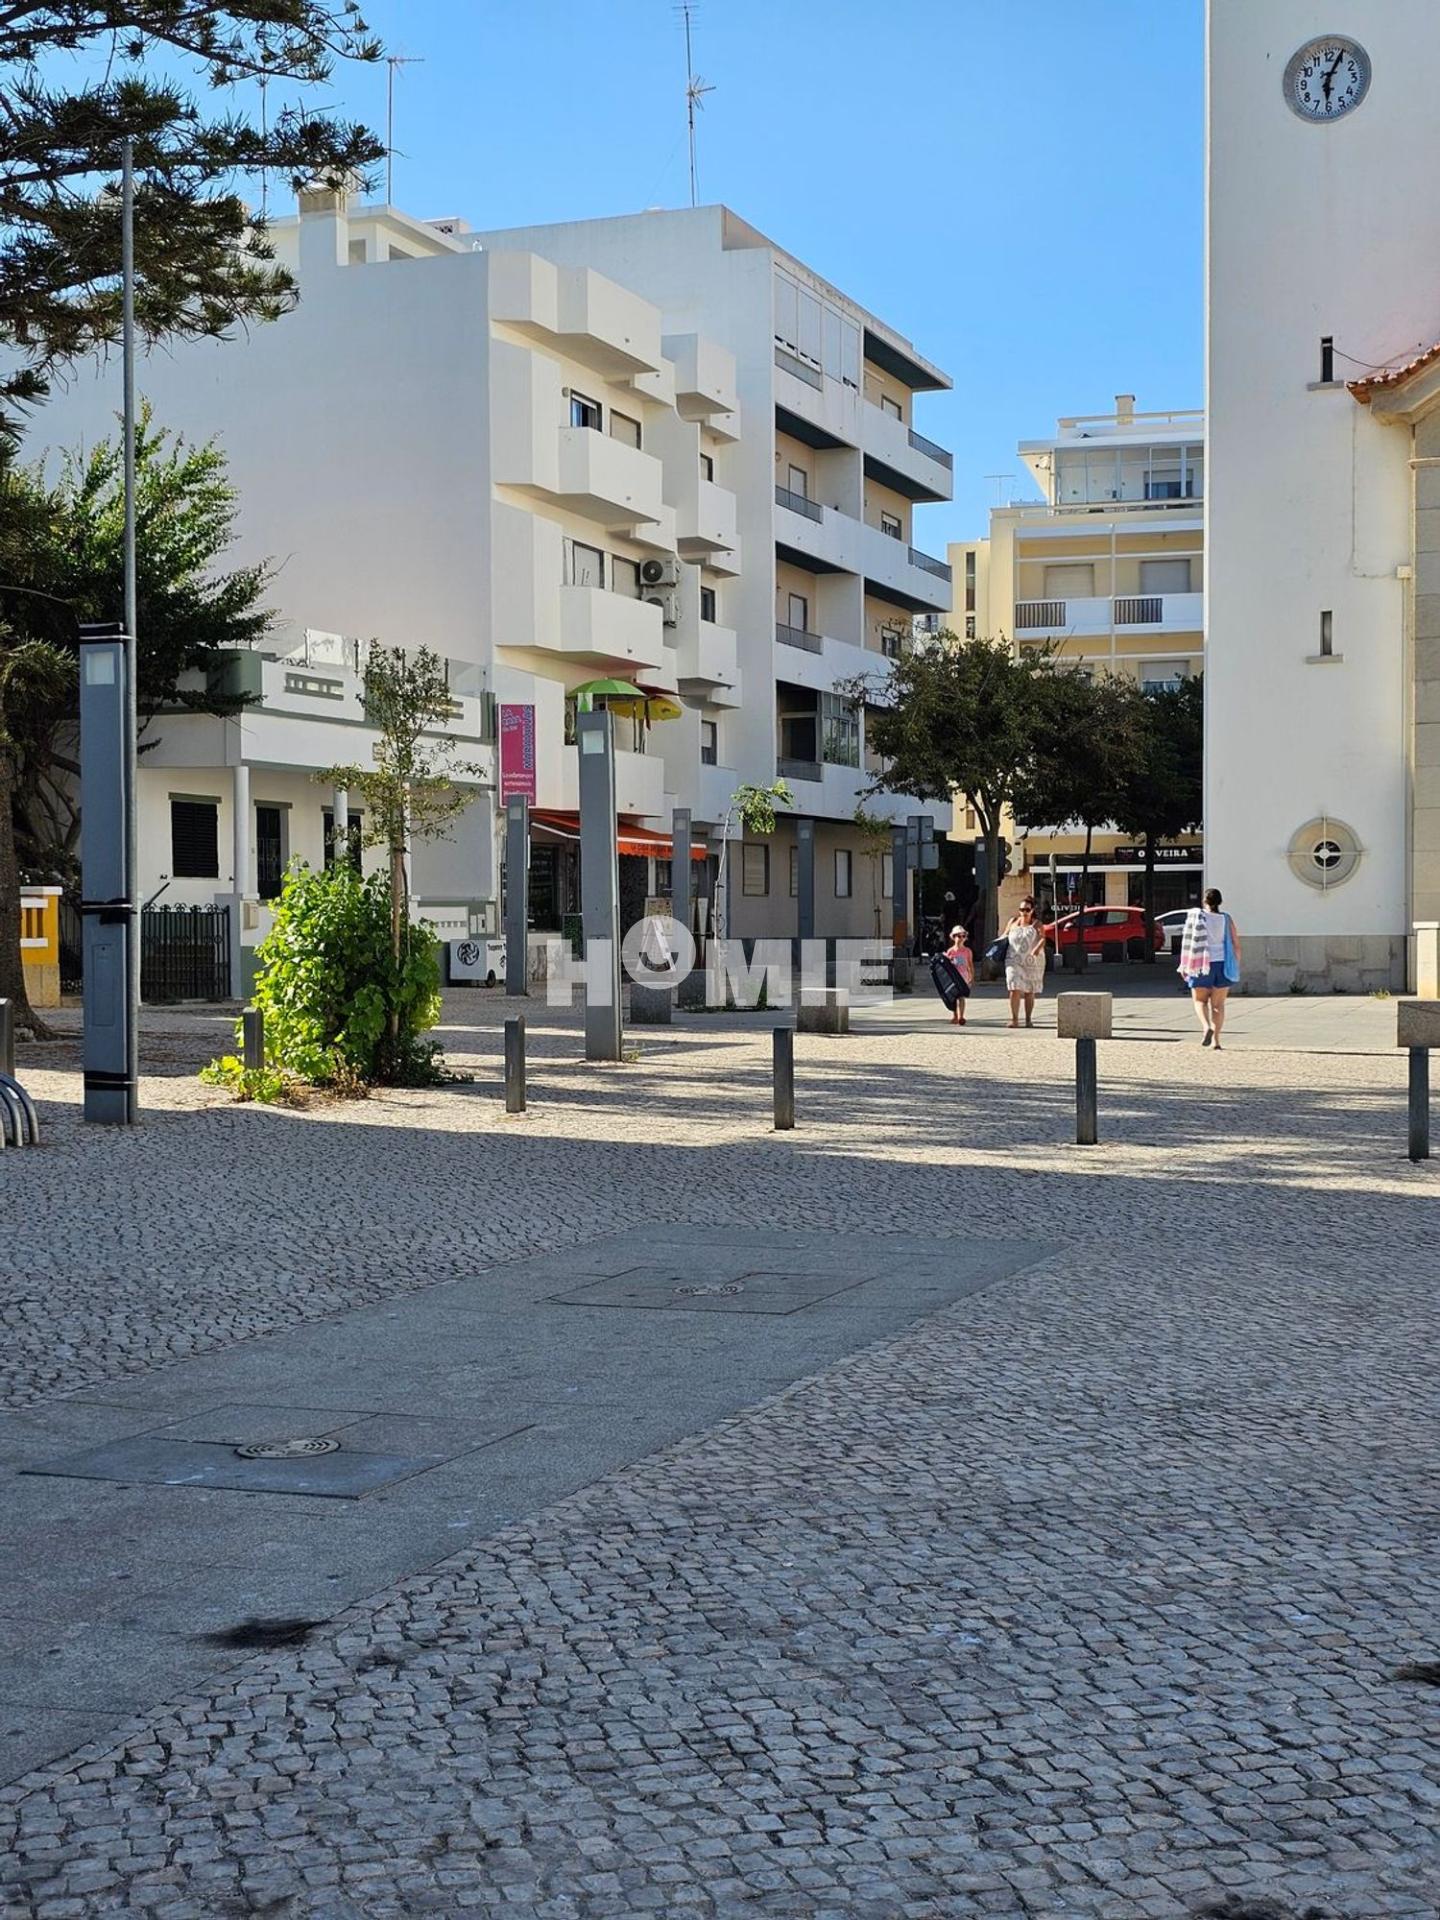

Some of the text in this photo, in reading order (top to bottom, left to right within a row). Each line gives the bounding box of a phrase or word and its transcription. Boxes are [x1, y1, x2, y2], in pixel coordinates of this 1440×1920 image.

[1313, 57, 1321, 67] 11
[1324, 51, 1335, 62] 12
[1347, 60, 1355, 72] 2
[1303, 66, 1313, 78] 10
[1350, 72, 1358, 83] 3
[1300, 80, 1308, 91] 9
[1345, 85, 1354, 96] 4
[1303, 92, 1311, 103] 8
[1337, 96, 1346, 106] 5
[1313, 100, 1321, 111] 7
[1325, 101, 1333, 112] 6
[1138, 849, 1188, 858] OVEIRA
